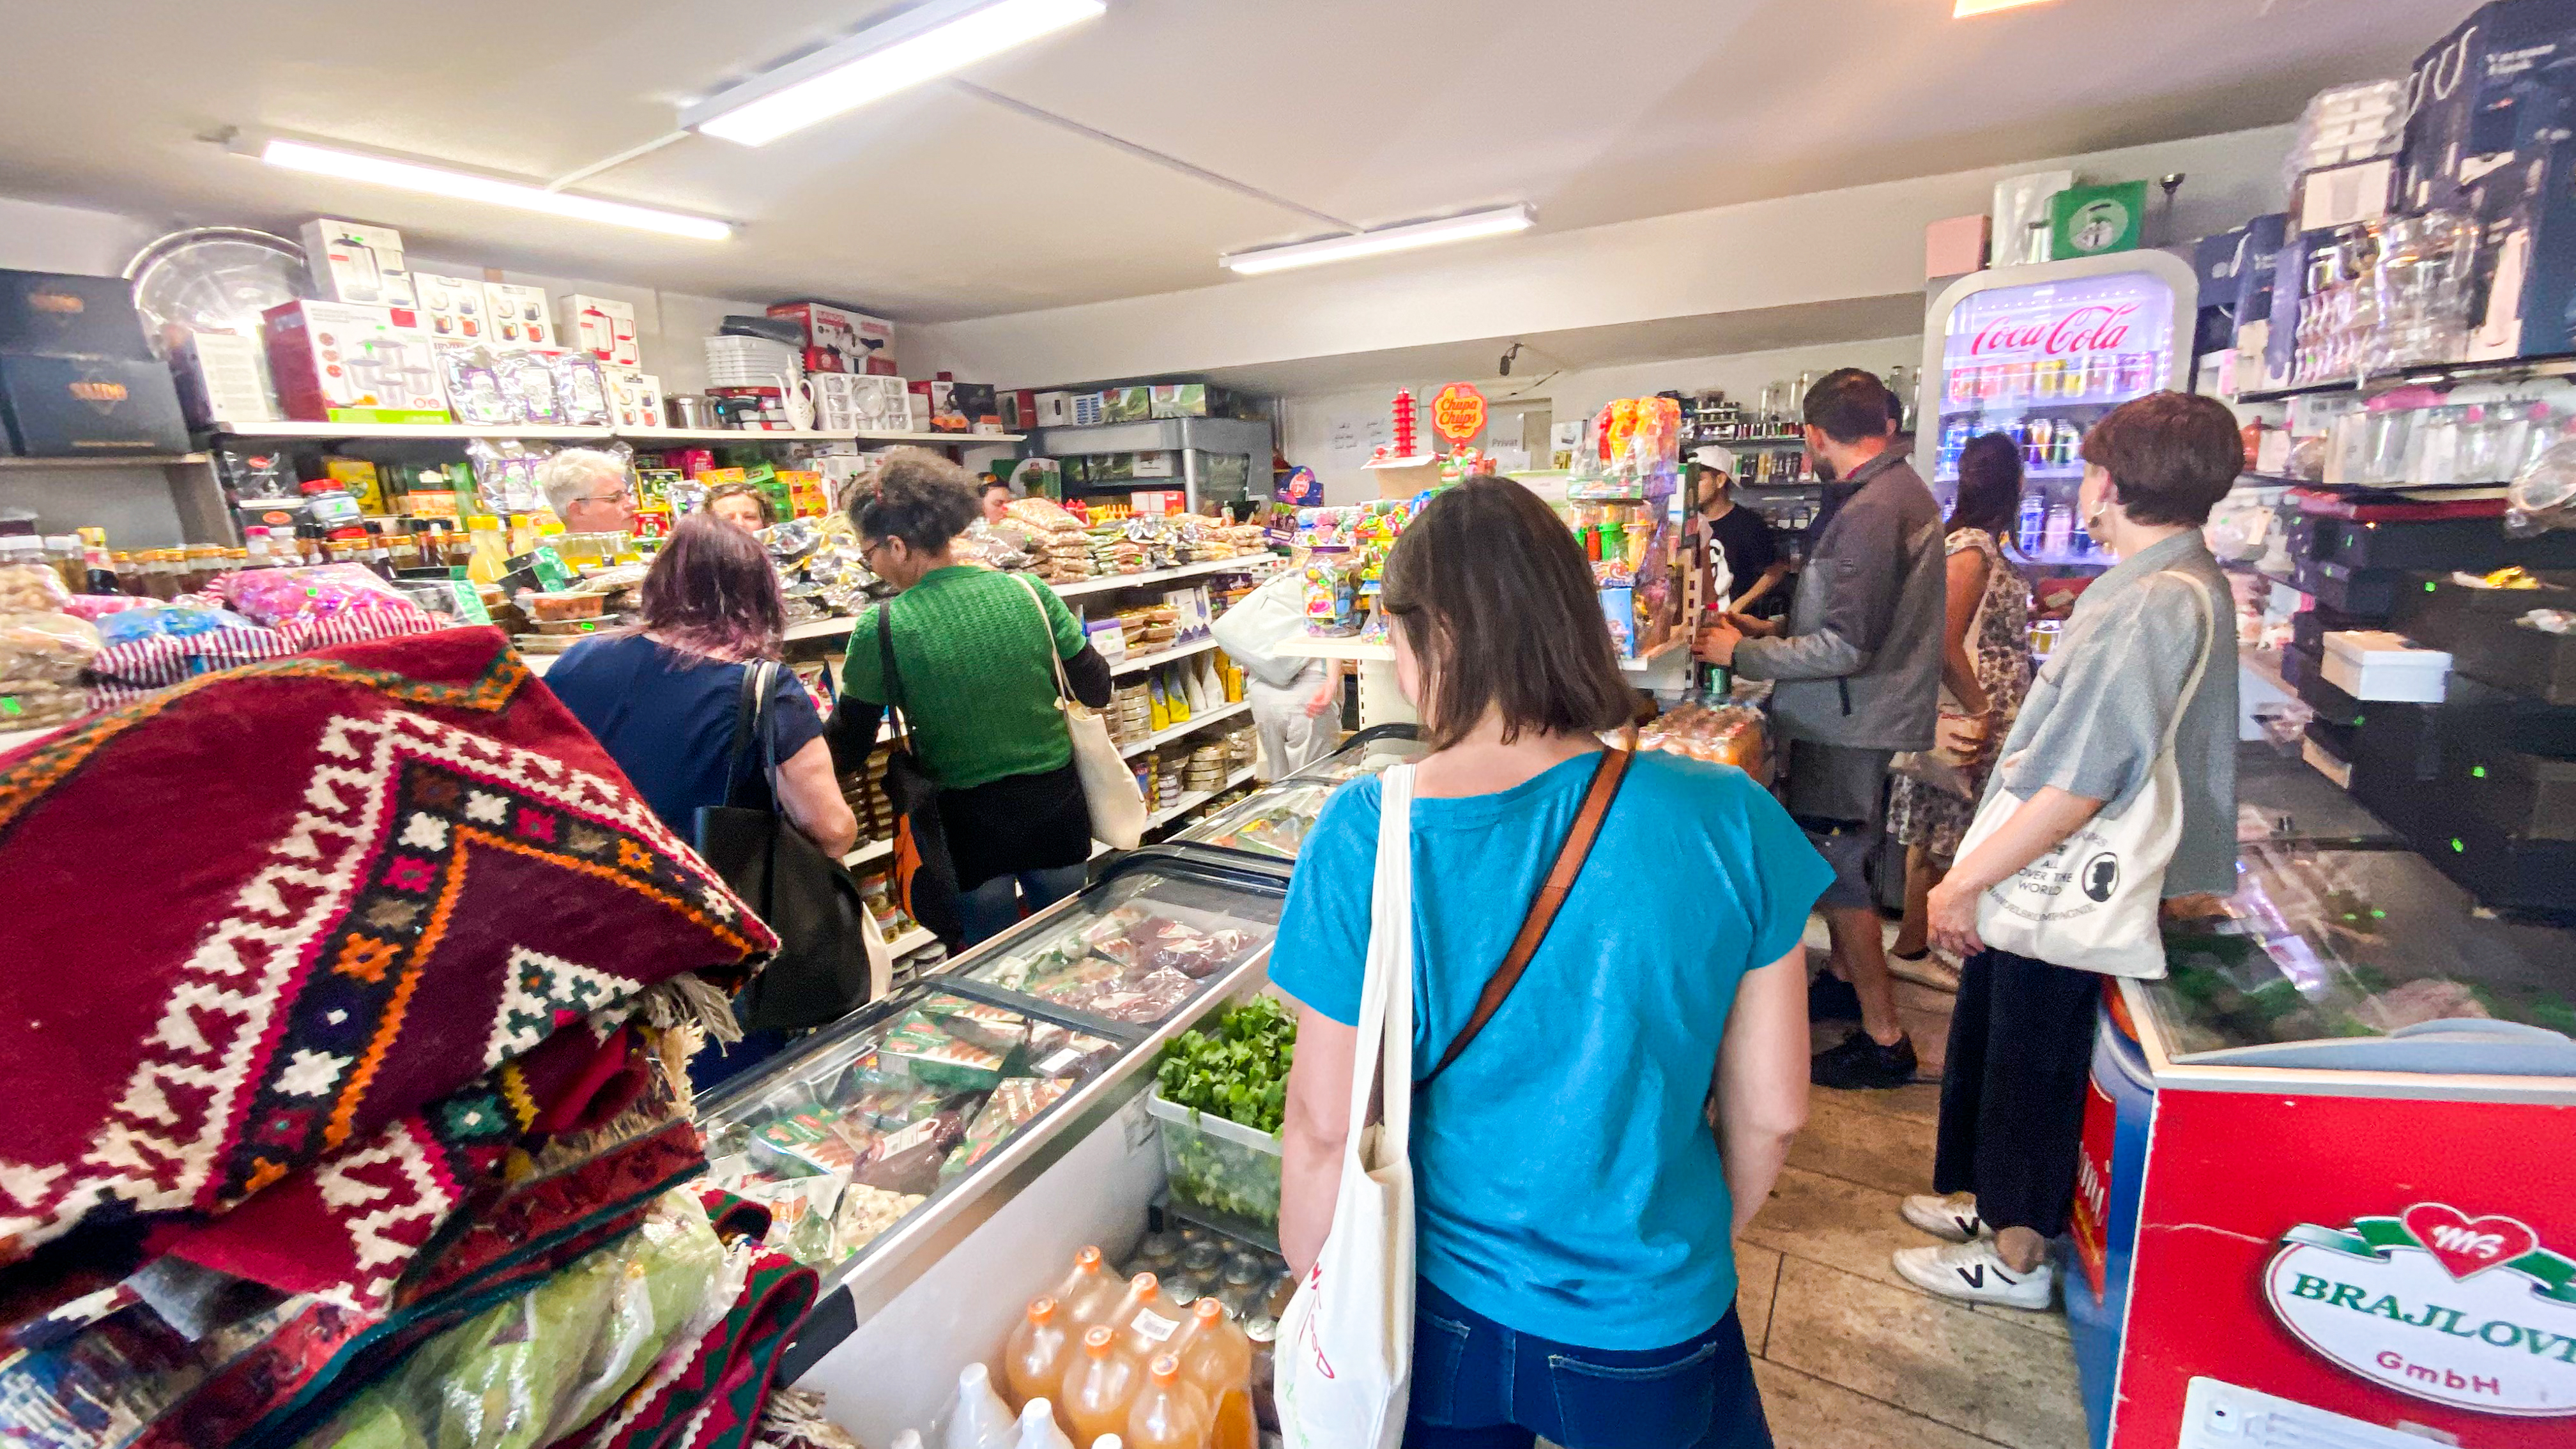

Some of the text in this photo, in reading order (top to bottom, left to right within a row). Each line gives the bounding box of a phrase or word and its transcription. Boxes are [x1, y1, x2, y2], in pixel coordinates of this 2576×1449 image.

[1441, 399, 1478, 413] Chupa
[1439, 413, 1477, 431] Chups
[1492, 439, 1518, 447] Privat
[2019, 868, 2048, 880] OVER
[2377, 1351, 2501, 1395] GmbH
